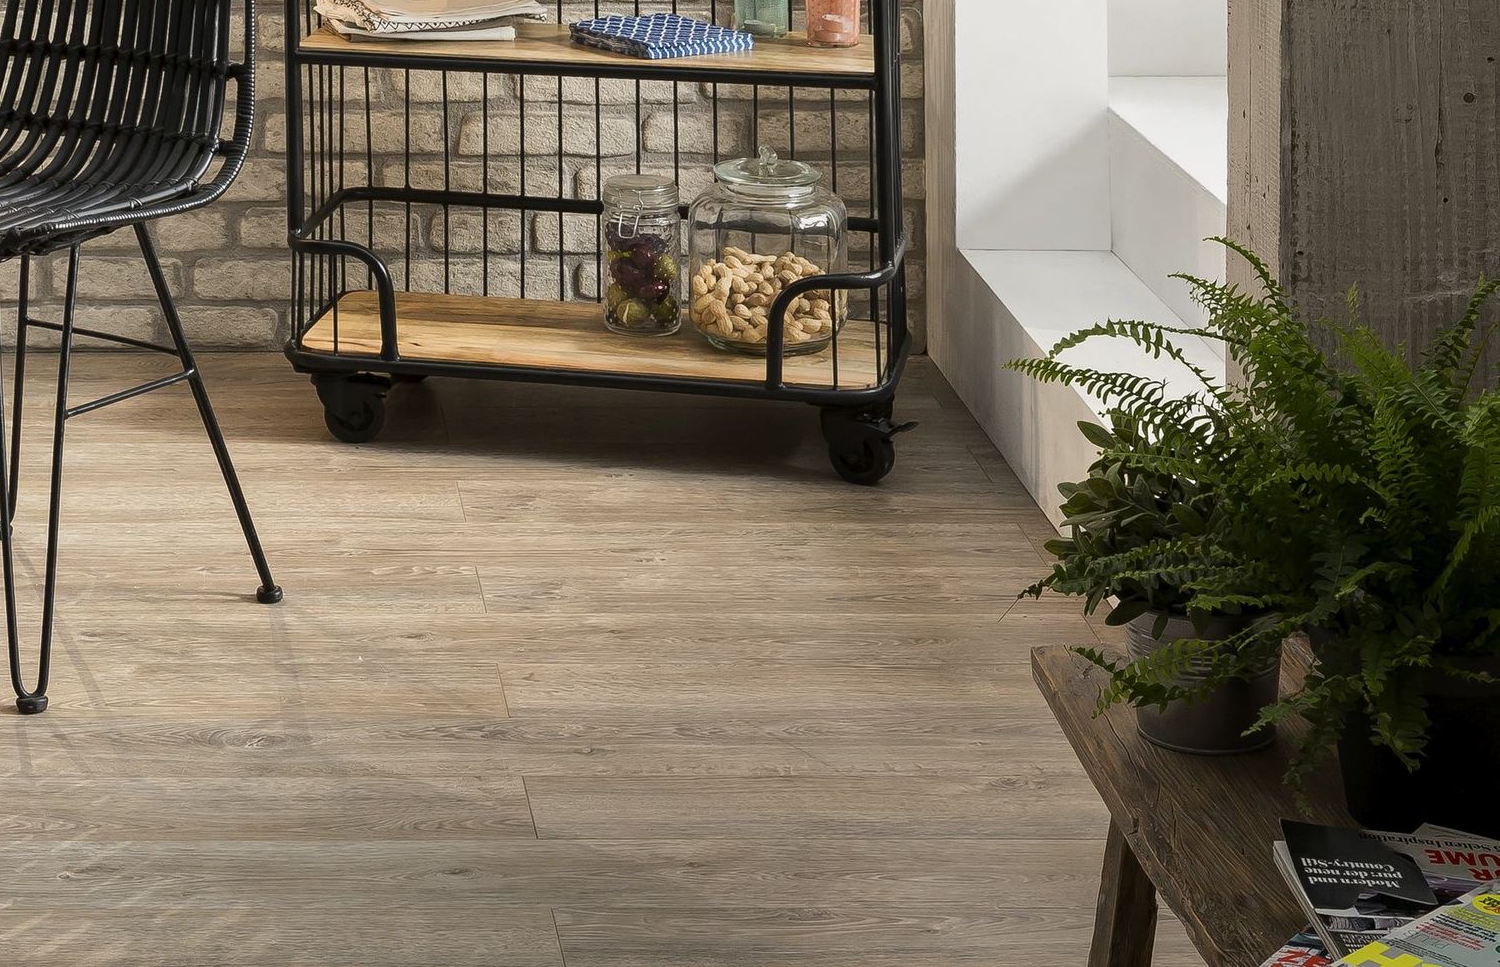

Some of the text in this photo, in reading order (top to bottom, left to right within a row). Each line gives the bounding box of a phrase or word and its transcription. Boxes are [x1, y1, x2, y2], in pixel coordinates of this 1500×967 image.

[1300, 857, 1395, 872] Country-Stil
[1304, 867, 1341, 876] neue
[1343, 870, 1369, 879] der
[1307, 876, 1400, 889] Modern und
